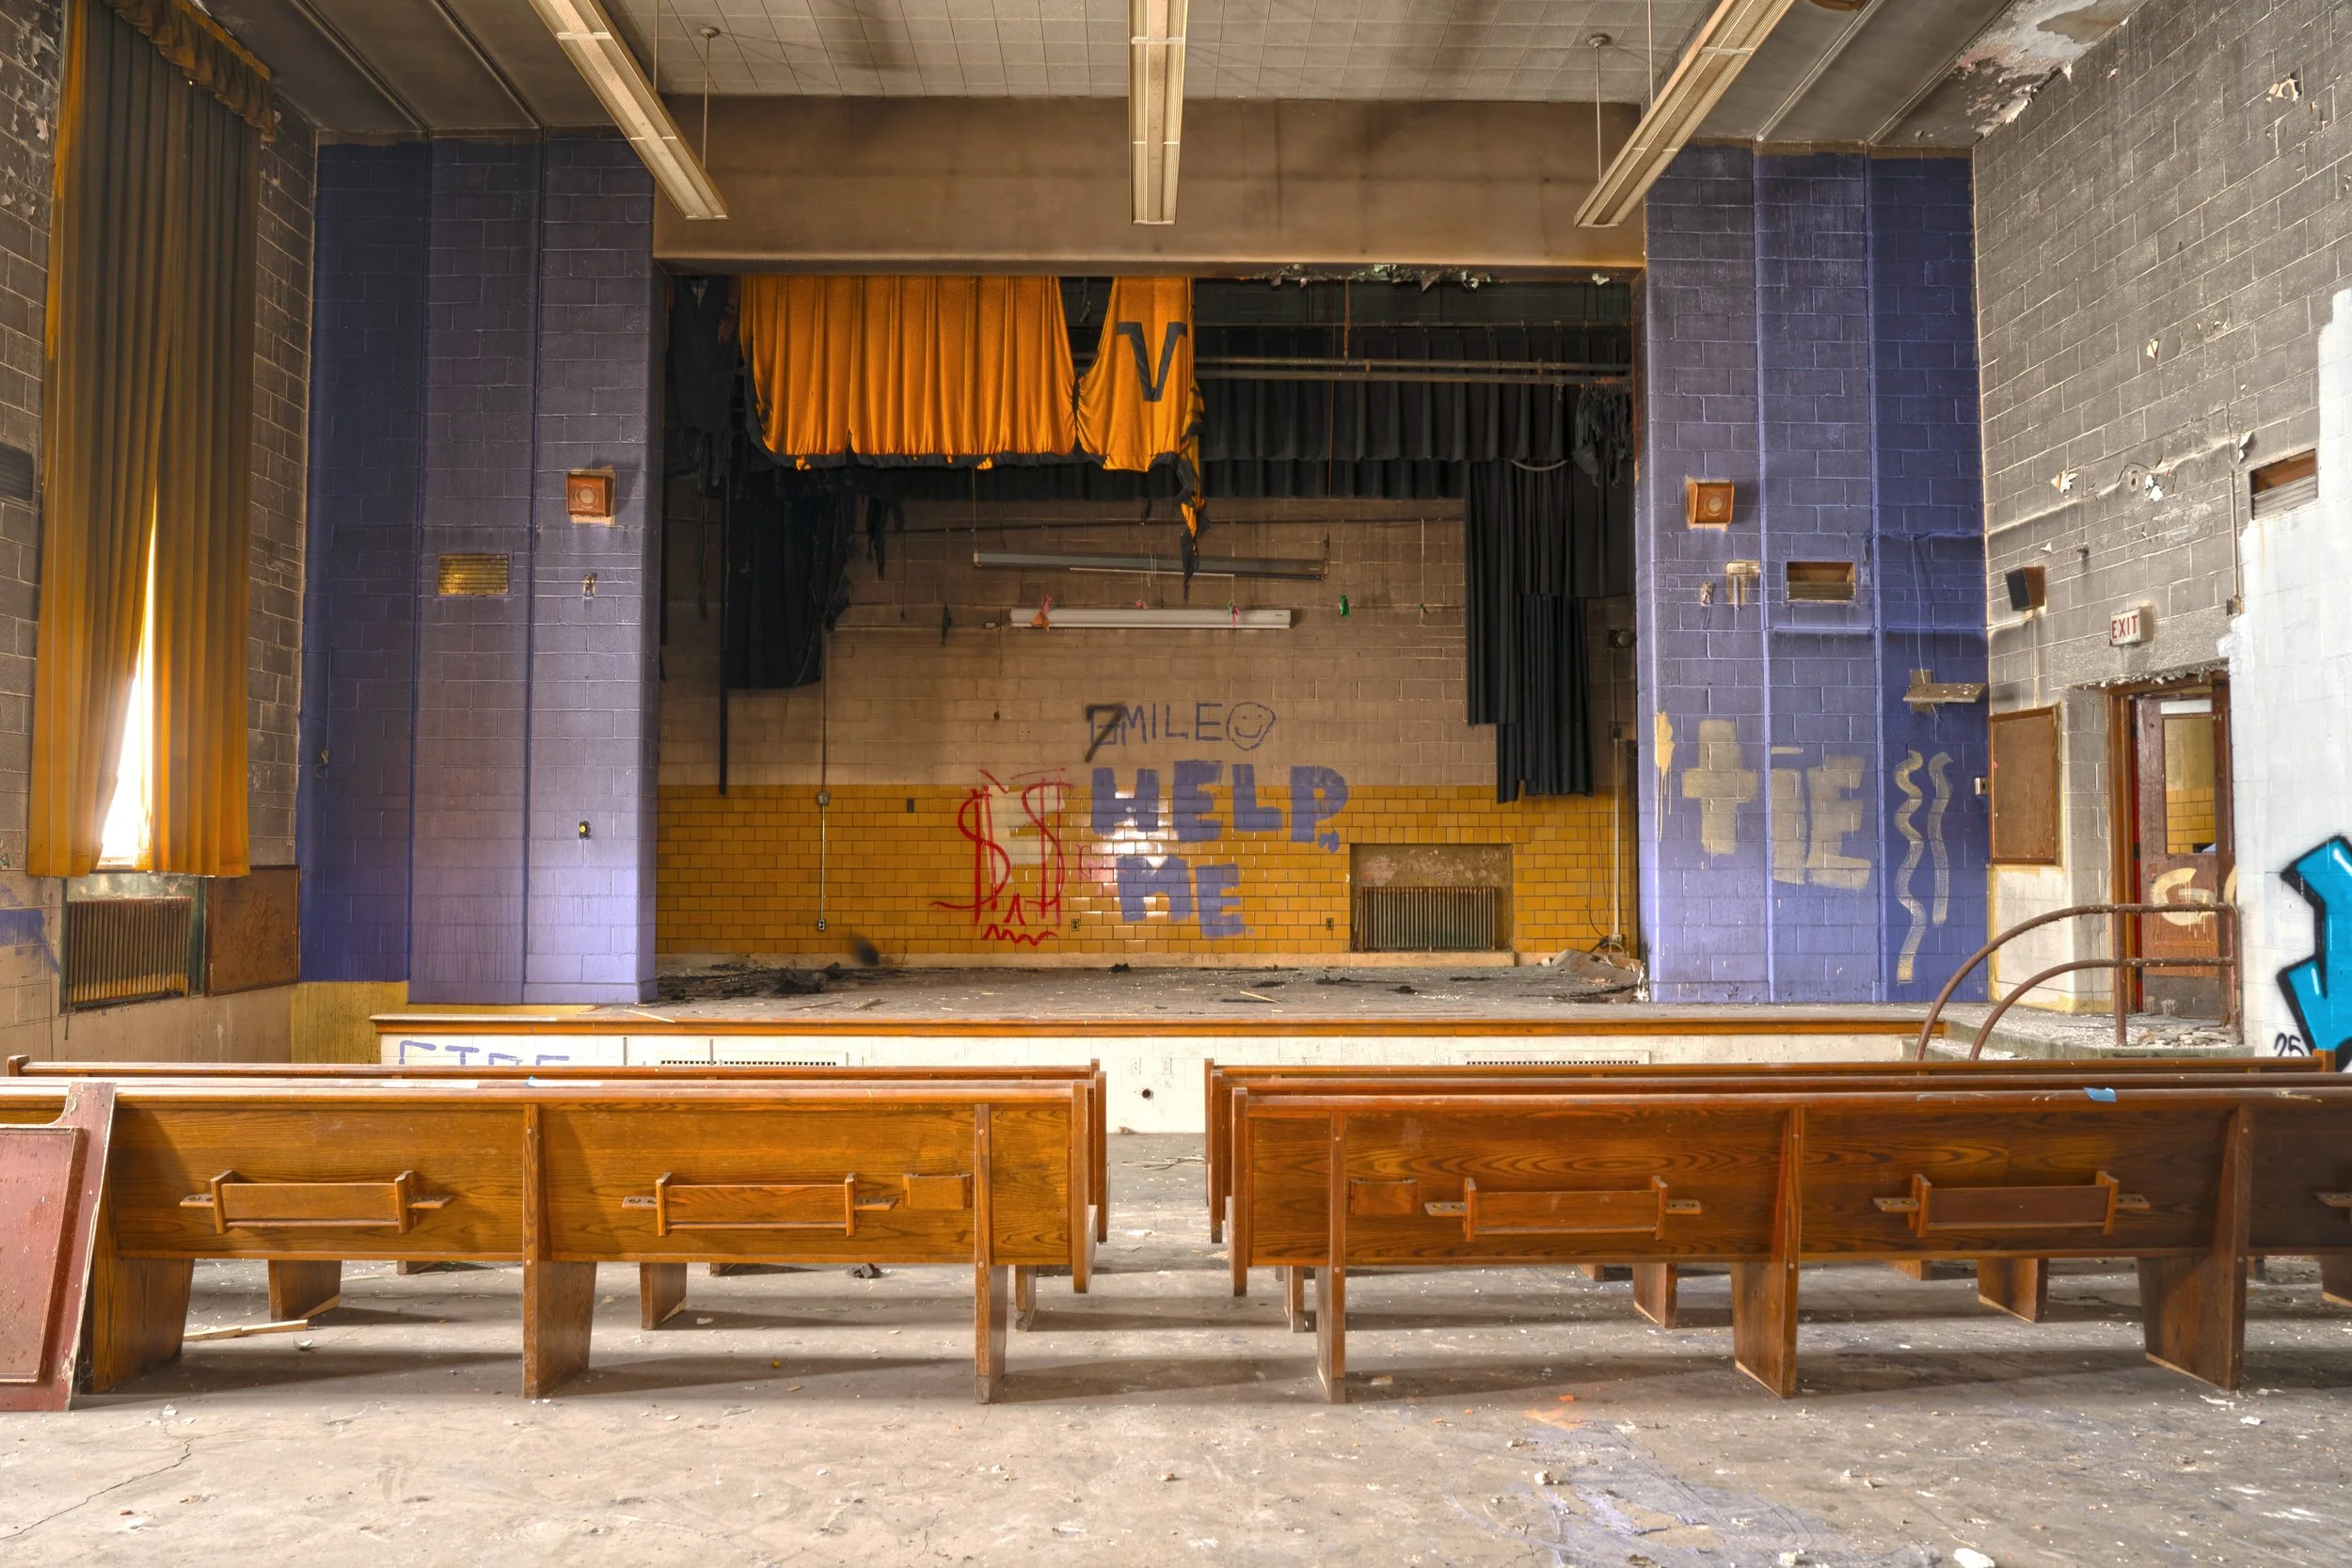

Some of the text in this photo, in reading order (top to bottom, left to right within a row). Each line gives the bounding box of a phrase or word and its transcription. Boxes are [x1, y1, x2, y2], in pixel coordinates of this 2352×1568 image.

[1117, 322, 1187, 403] V
[2110, 613, 2138, 640] EXIT
[1115, 855, 1246, 939] ME
